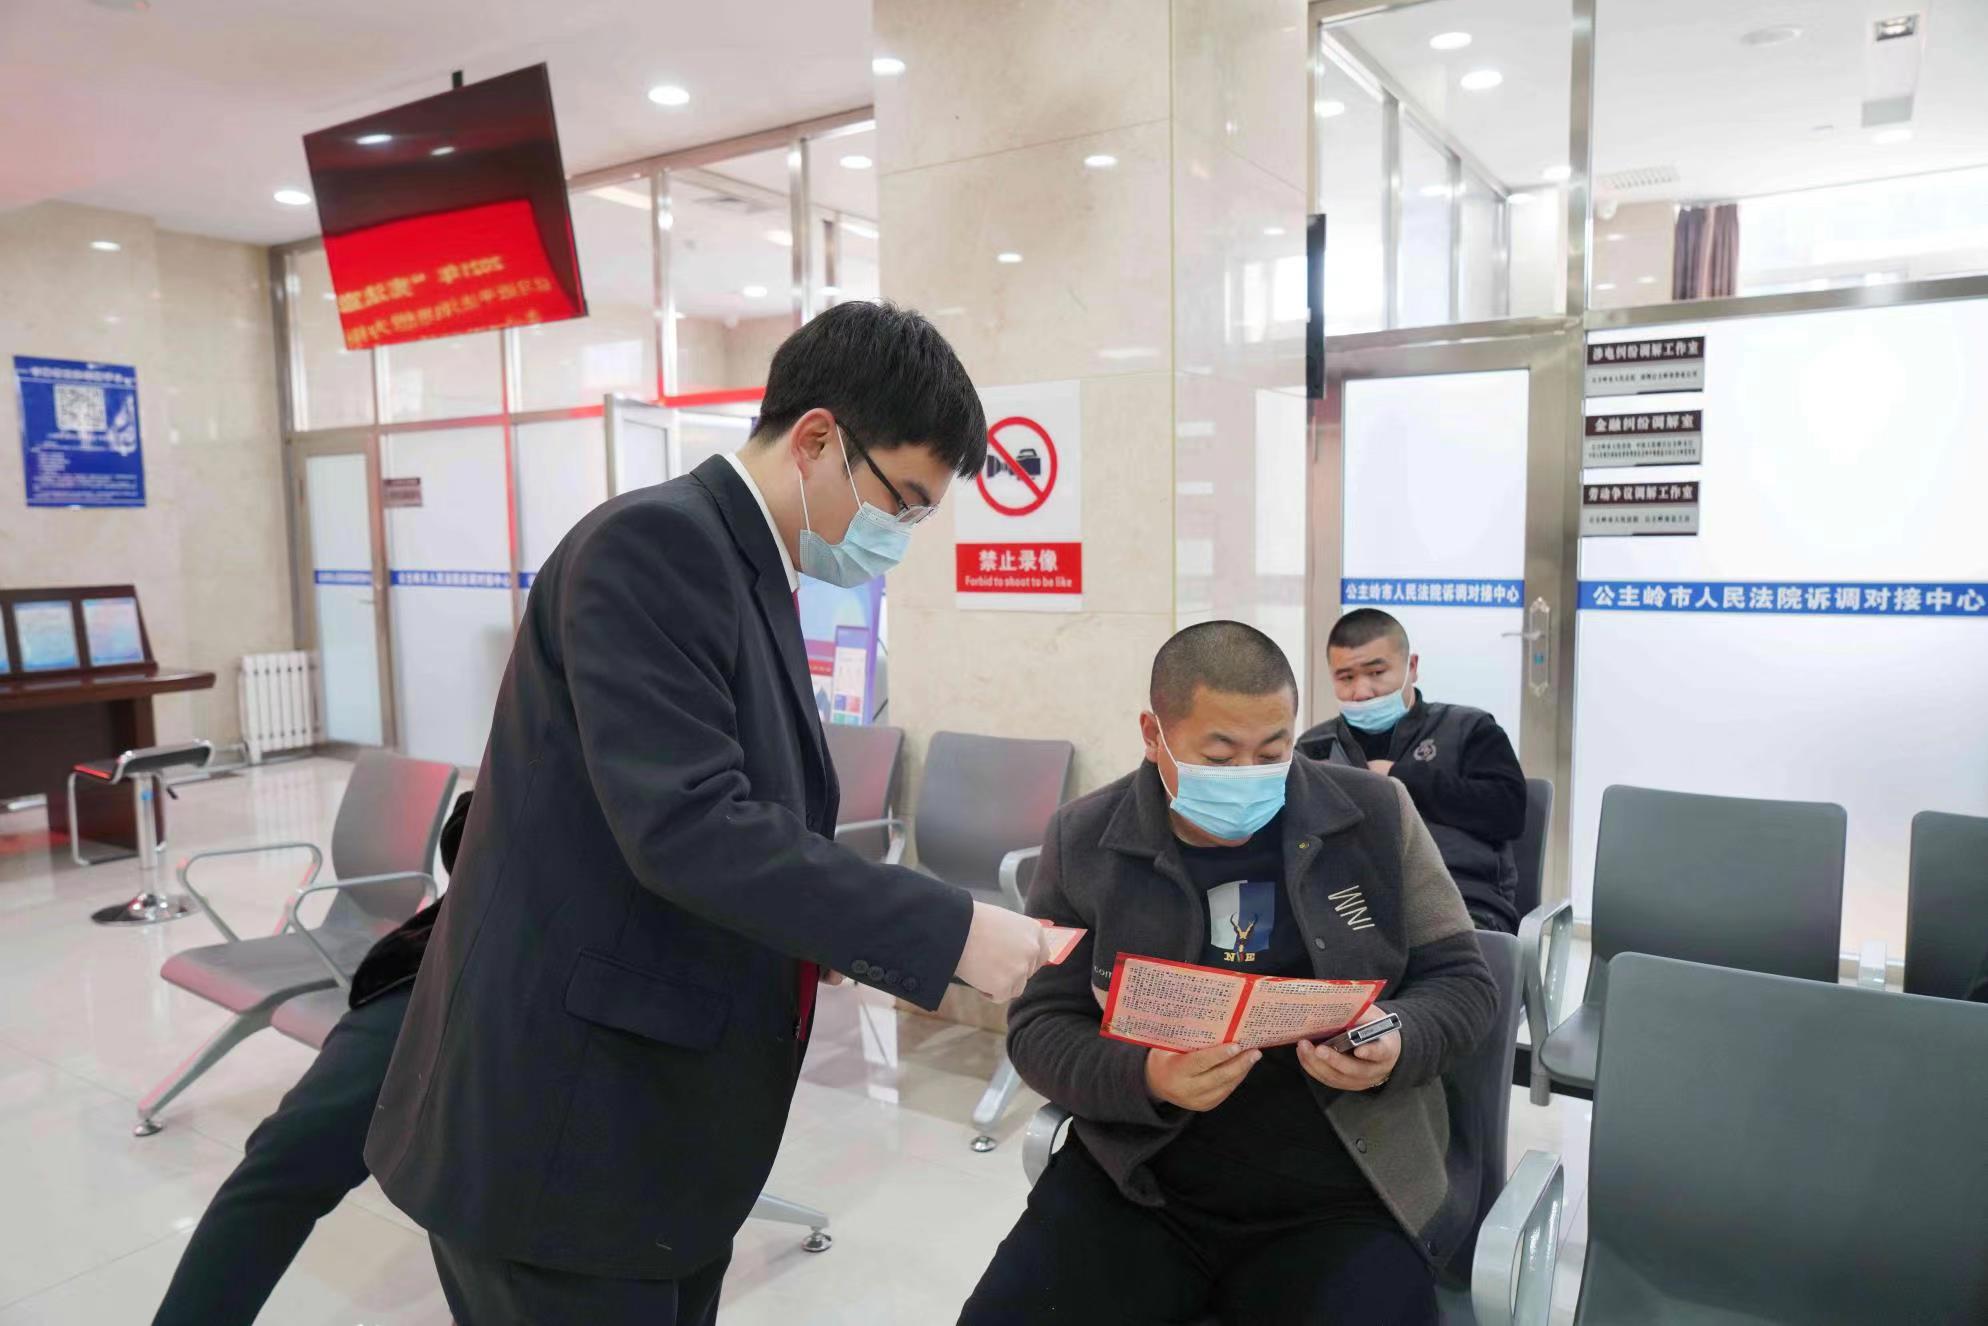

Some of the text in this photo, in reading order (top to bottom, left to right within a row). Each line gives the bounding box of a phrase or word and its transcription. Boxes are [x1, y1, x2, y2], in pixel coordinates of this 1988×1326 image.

[979, 549, 1058, 572] 禁止录像
[965, 576, 993, 587] Forbid
[994, 577, 1004, 587] to
[1031, 577, 1041, 588] to
[1042, 576, 1055, 588] be
[1055, 576, 1072, 588] like
[1345, 582, 1520, 604] 公主岭市人民法院诉调对接中心
[1592, 585, 1986, 612] 公主岭市人民法院诉调对接中心
